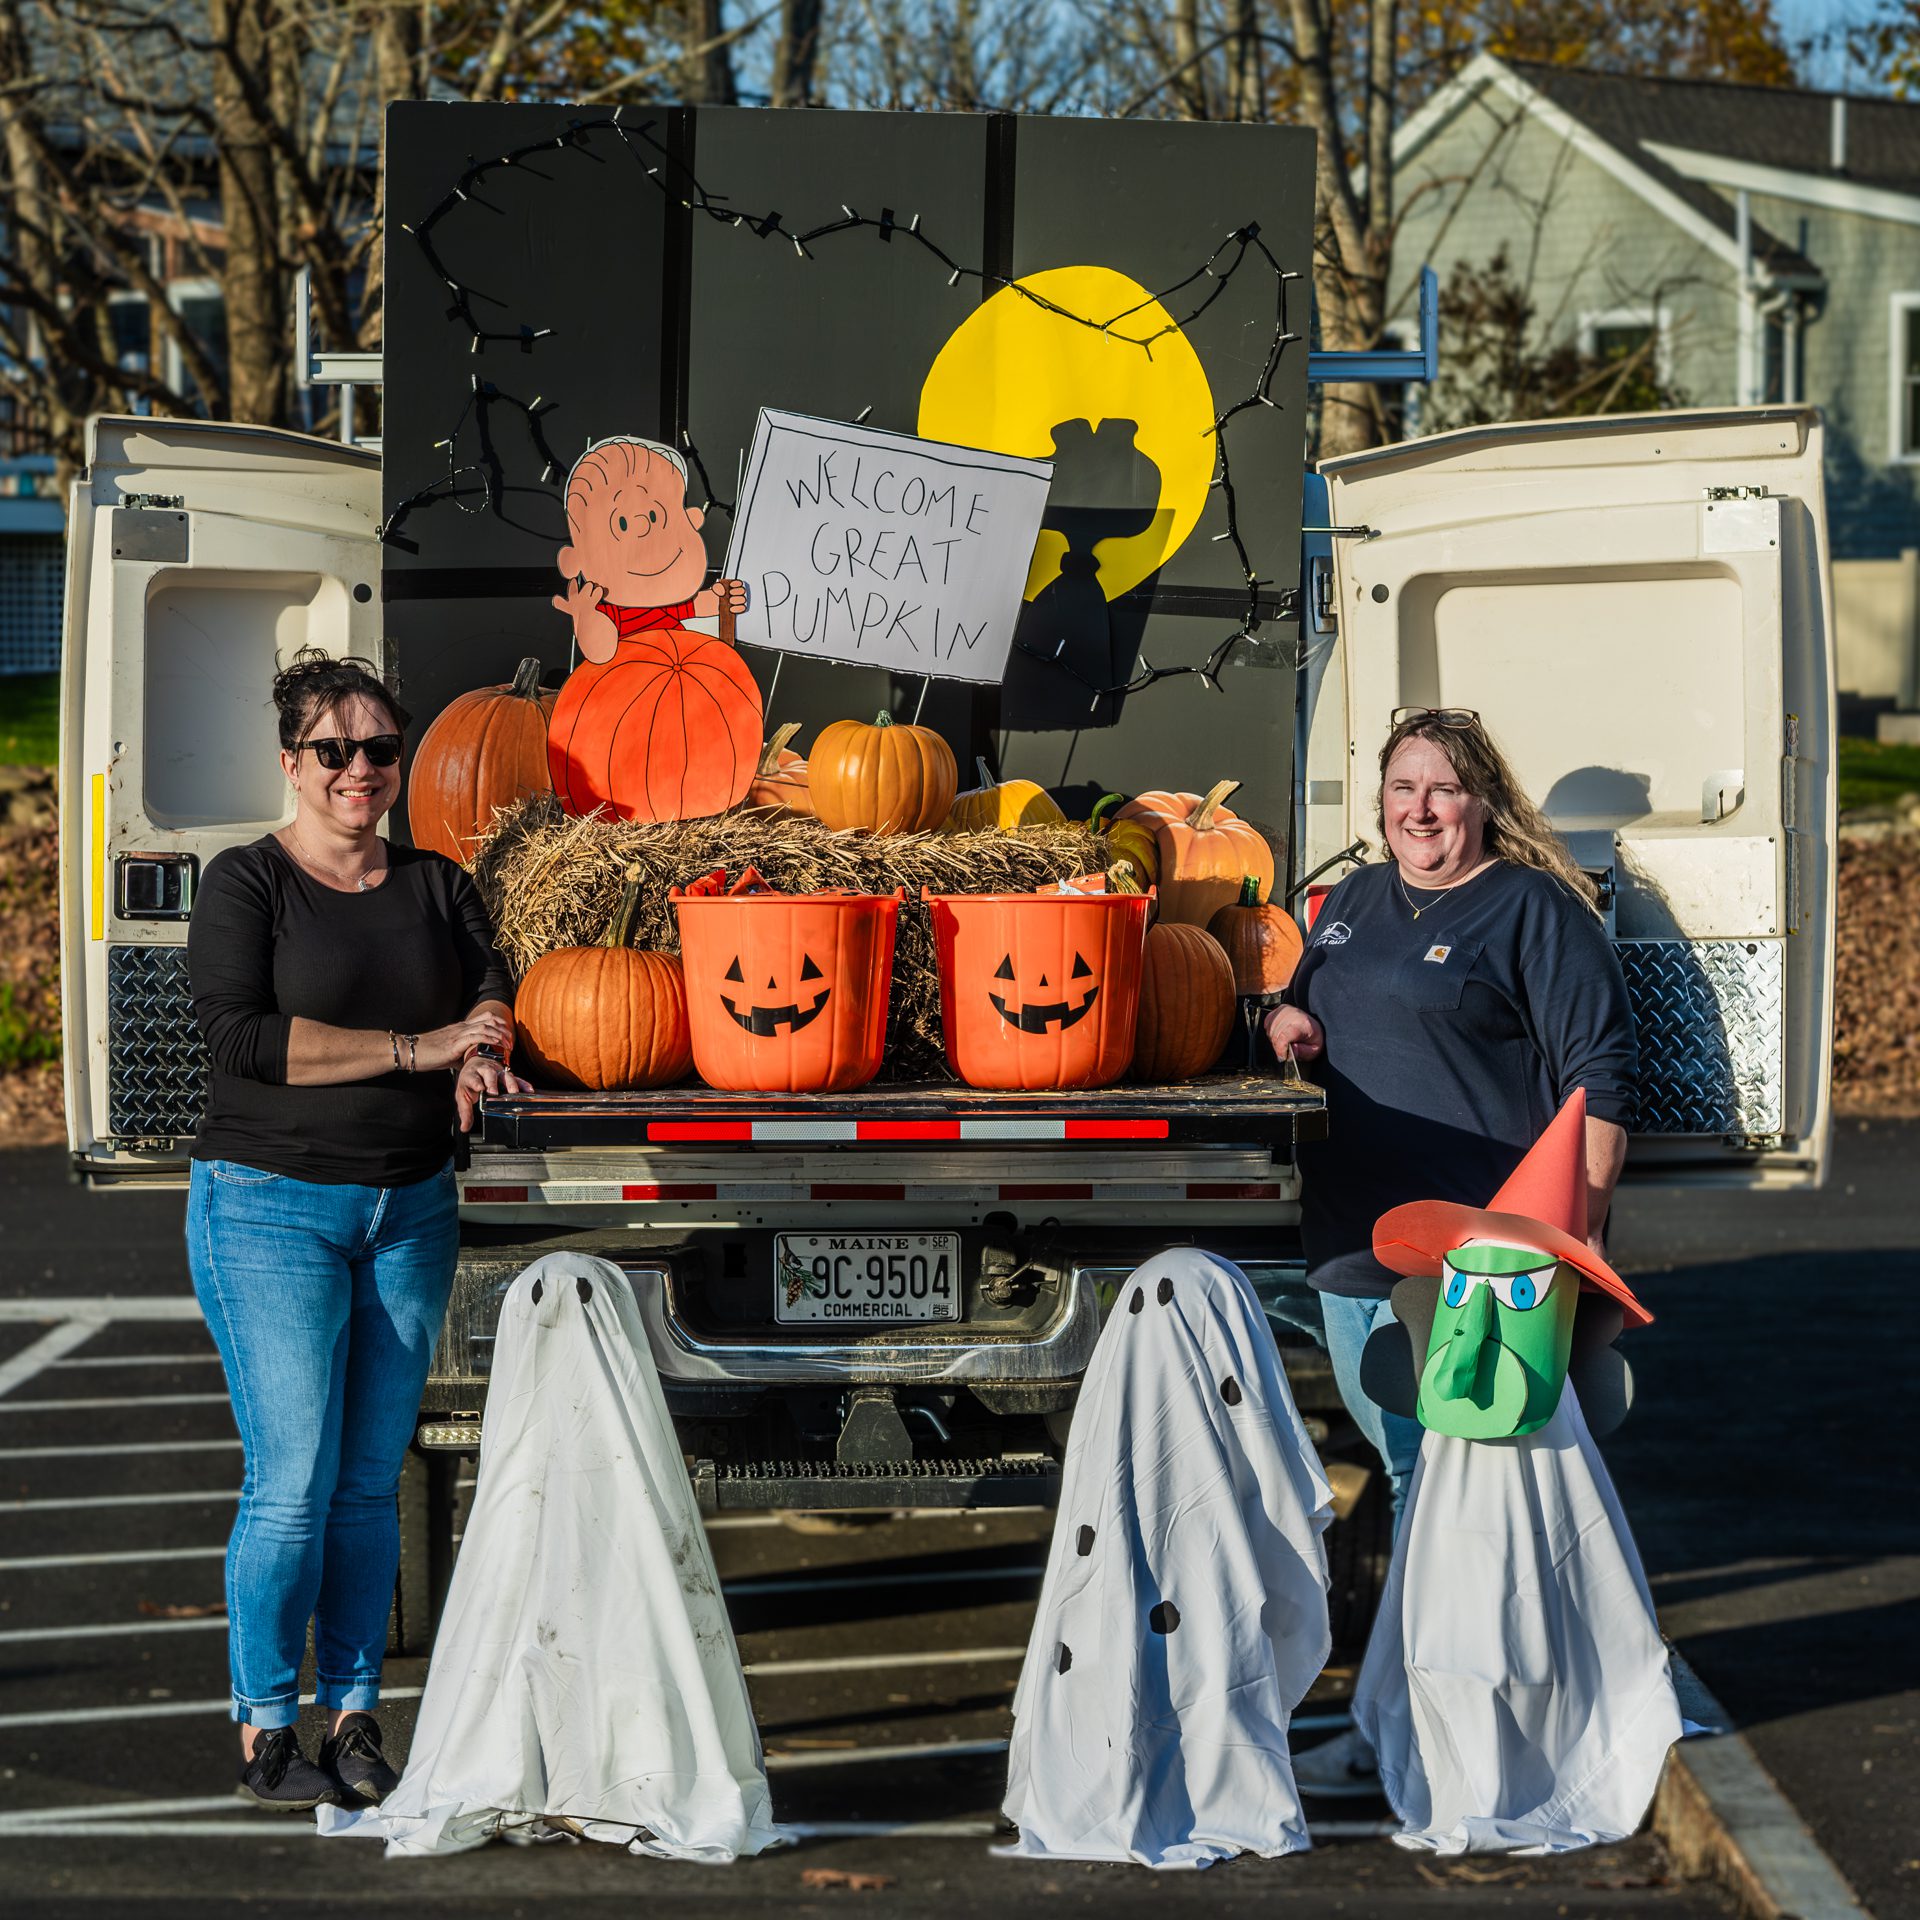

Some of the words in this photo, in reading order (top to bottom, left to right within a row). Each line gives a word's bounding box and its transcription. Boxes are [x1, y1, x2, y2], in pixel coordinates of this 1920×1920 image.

[786, 450, 990, 535] WELCOME
[811, 522, 963, 585] GREAT
[762, 571, 988, 660] PUMPKIN
[828, 1238, 909, 1250] MAINE
[932, 1236, 949, 1248] SEP
[823, 1303, 913, 1317] COMMERCIAL
[932, 1306, 949, 1316] 25
